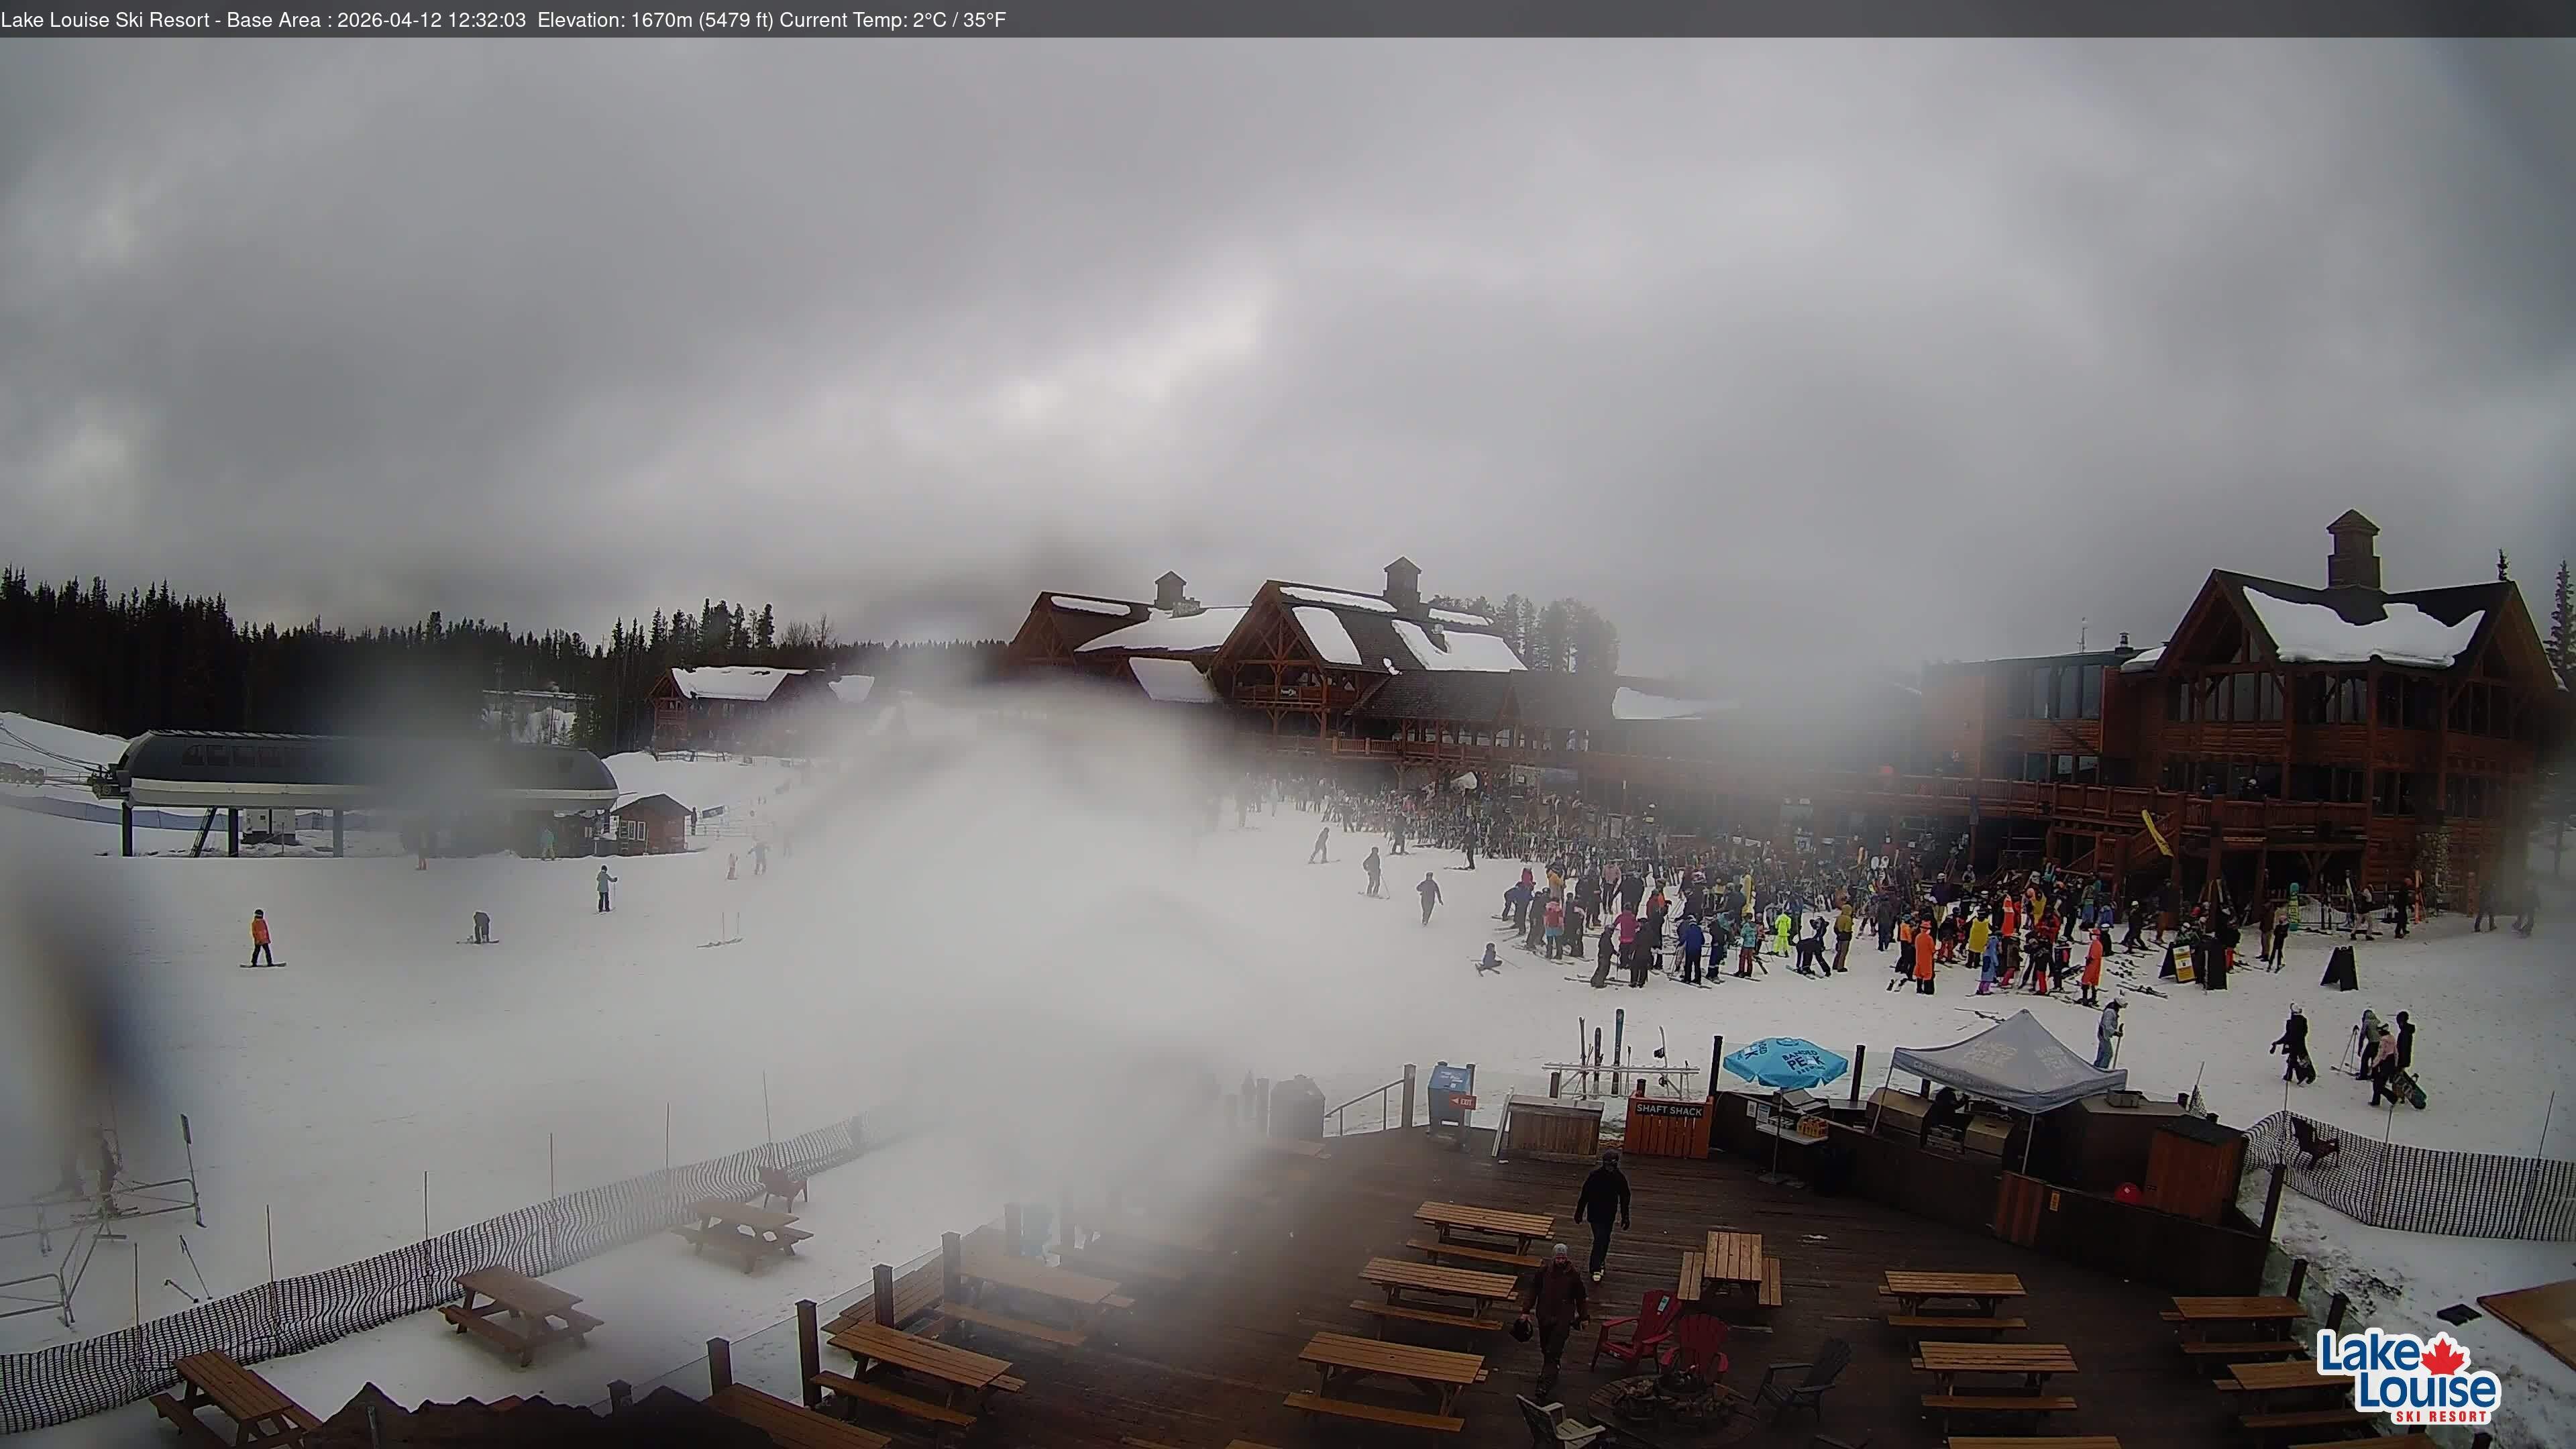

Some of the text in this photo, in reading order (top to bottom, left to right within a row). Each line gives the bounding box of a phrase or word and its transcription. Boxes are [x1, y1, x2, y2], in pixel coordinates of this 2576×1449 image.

[1782, 1050, 1818, 1061] BANDED
[1637, 1104, 1702, 1116] SHAFT SHACK
